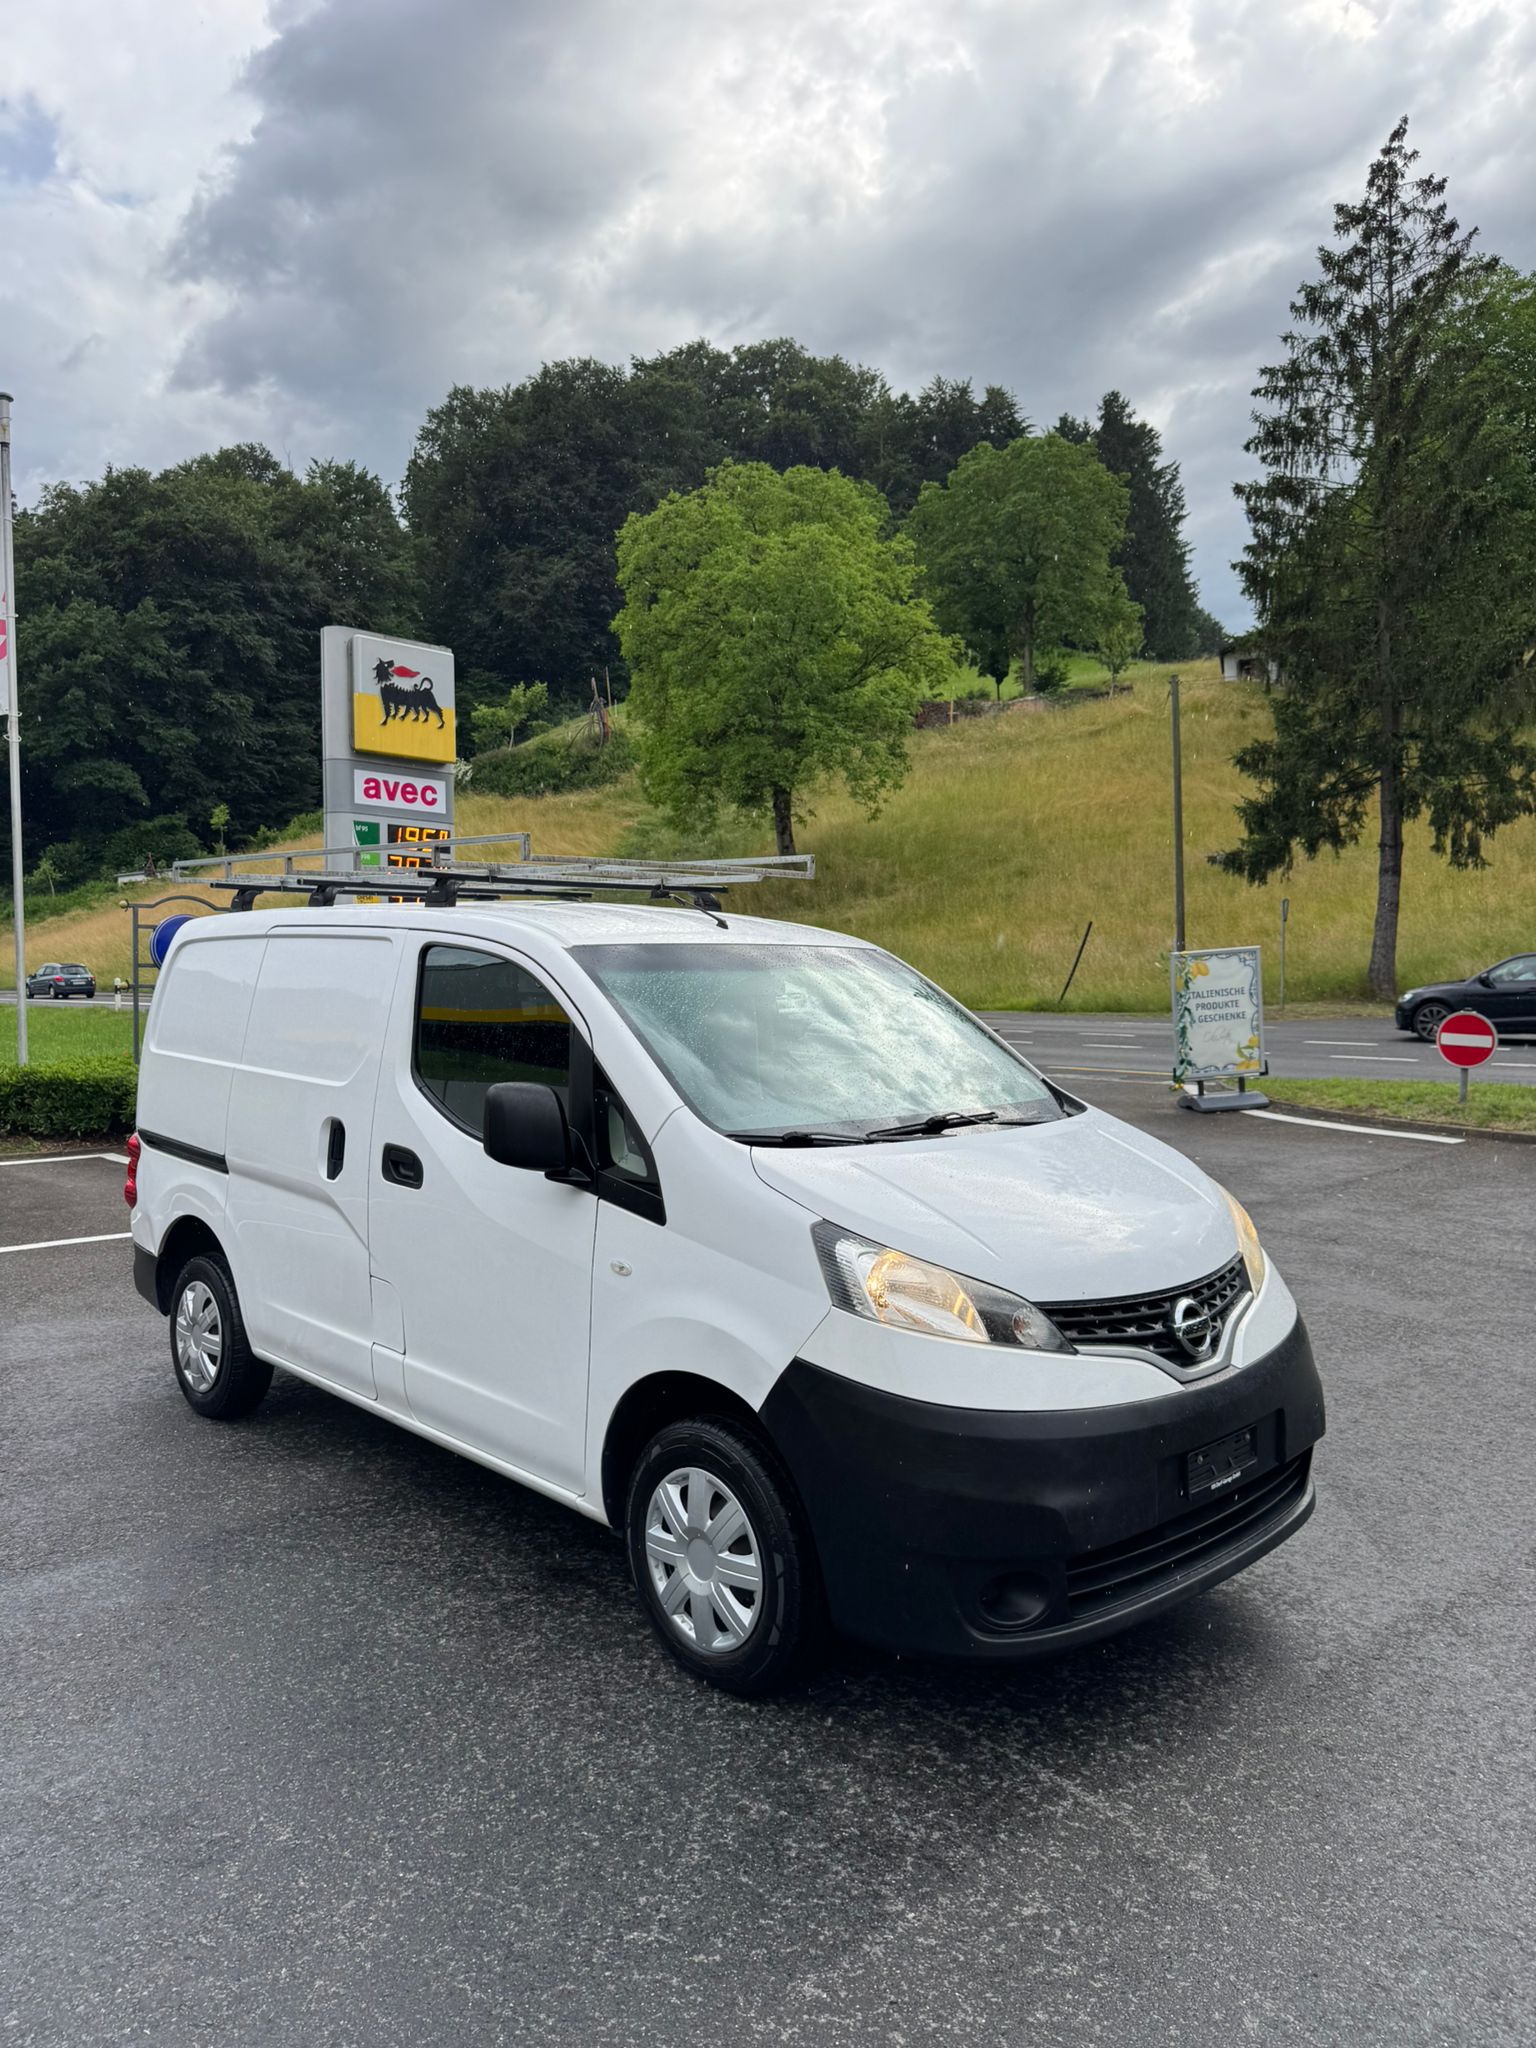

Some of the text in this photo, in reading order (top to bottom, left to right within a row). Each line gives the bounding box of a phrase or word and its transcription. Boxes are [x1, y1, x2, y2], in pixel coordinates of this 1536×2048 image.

[363, 777, 438, 807] avec
[1195, 999, 1240, 1011] PRODUKTE
[1198, 1010, 1247, 1023] GESCHENKE
